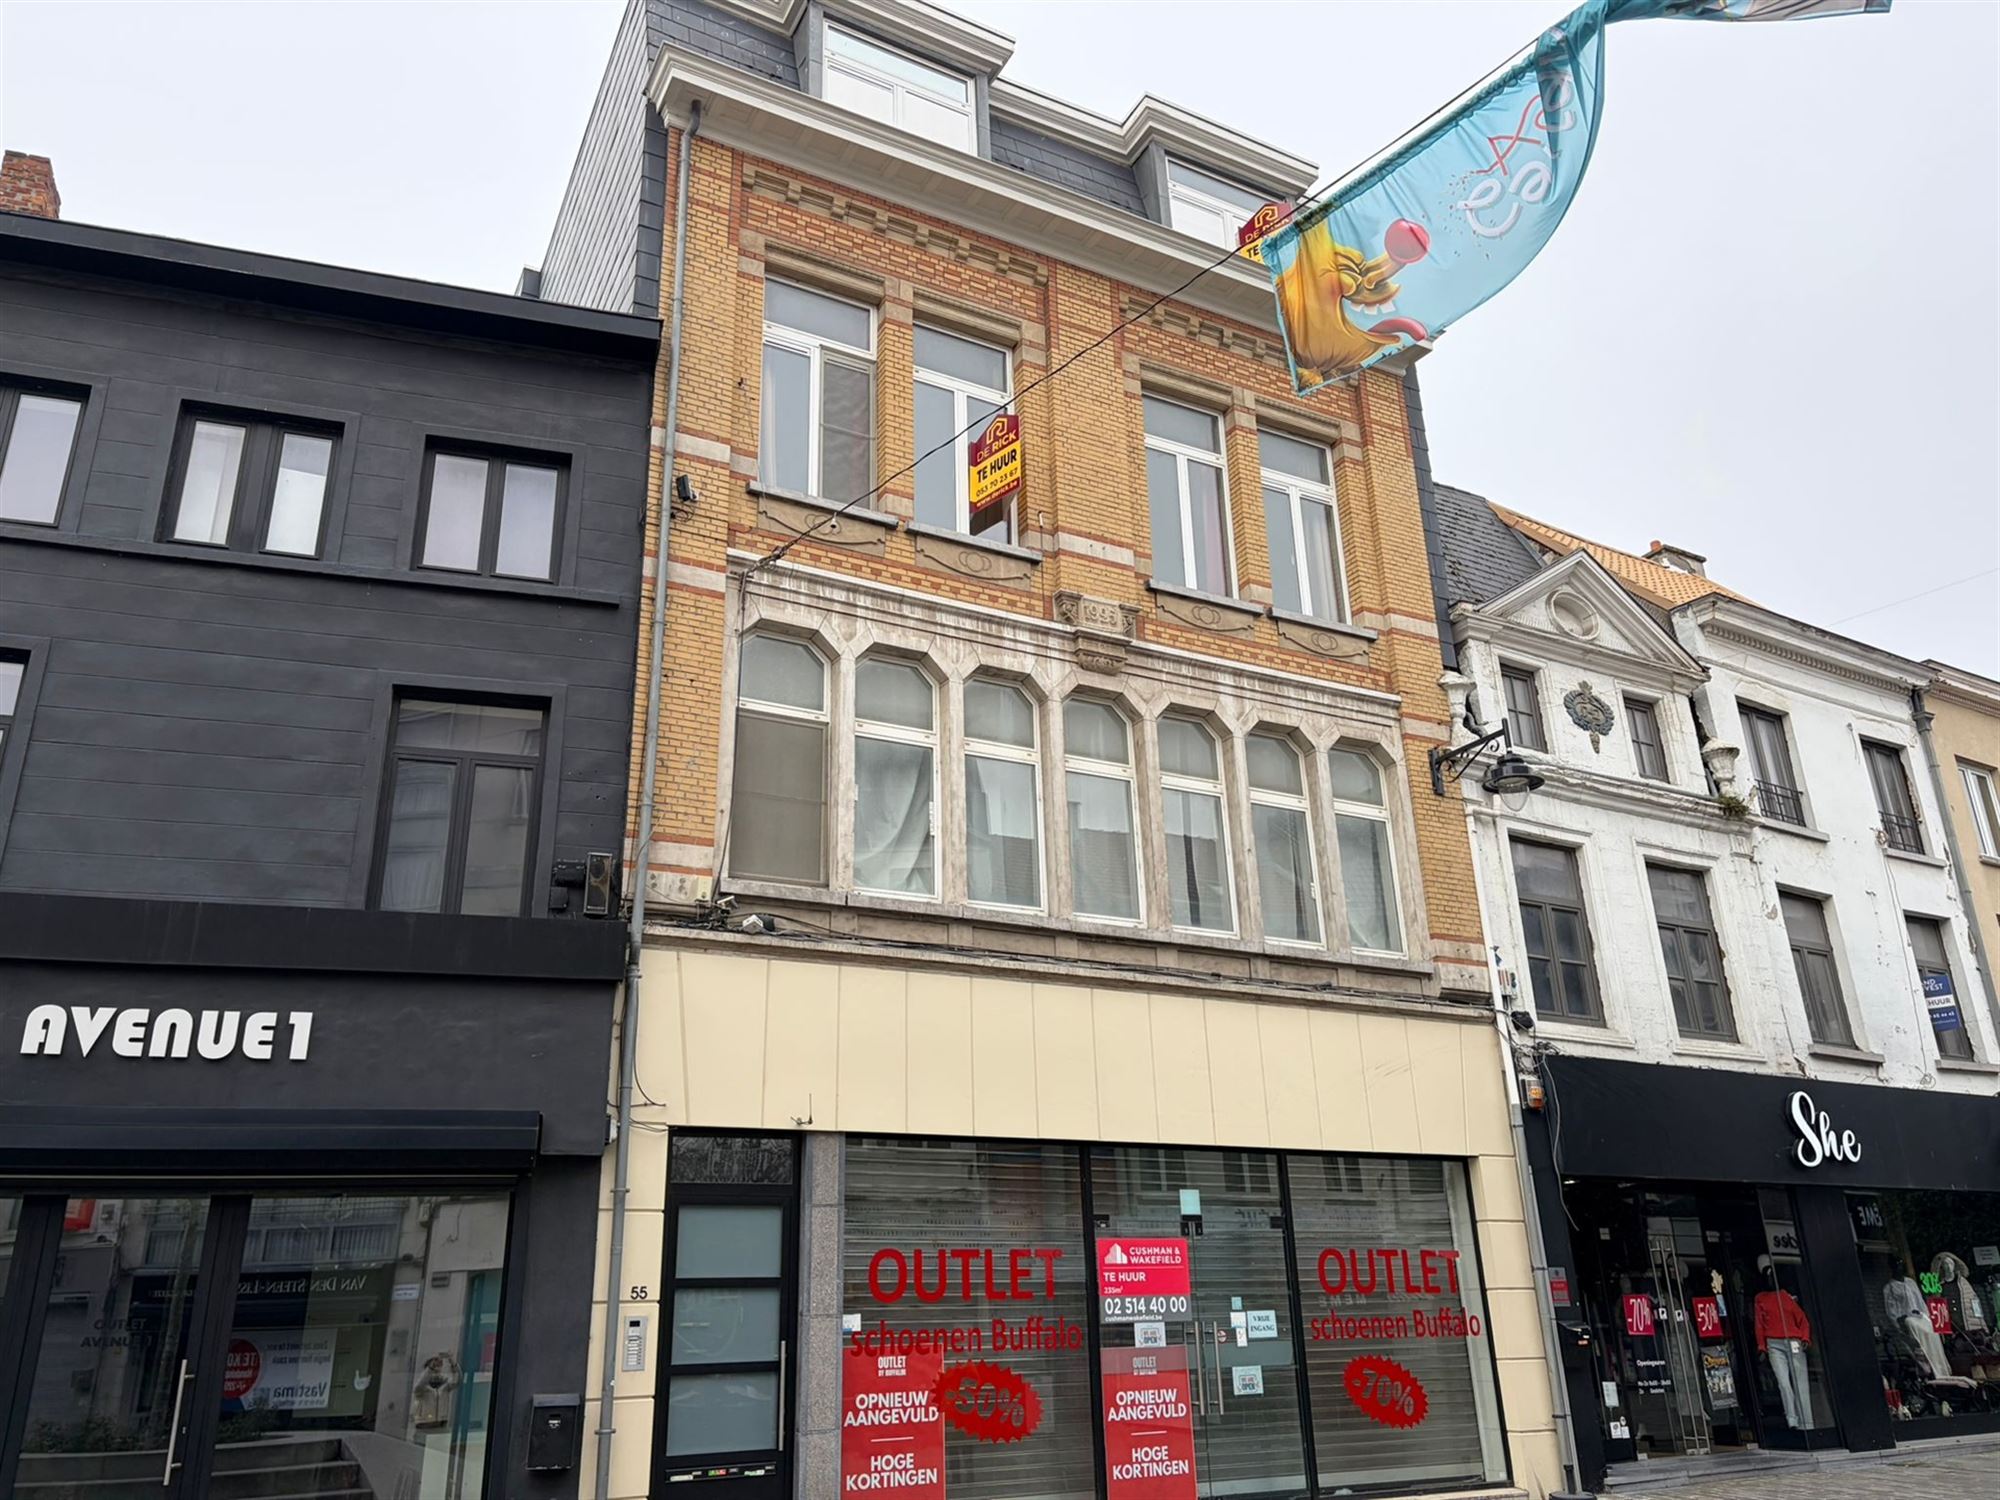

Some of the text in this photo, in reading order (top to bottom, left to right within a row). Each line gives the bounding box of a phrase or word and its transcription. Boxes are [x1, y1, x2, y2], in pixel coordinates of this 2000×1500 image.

[1246, 244, 1260, 259] TE
[976, 429, 1018, 463] DE RICK
[976, 448, 1018, 483] TE HUUR
[1791, 1090, 1861, 1167] She
[1129, 1247, 1181, 1255] CUSHMAN &
[1129, 1256, 1182, 1265] WAKEFIELD
[868, 1248, 1063, 1303] OUTLET
[1103, 1272, 1146, 1282] TE HUUR
[1317, 1248, 1461, 1296] OUTLET
[630, 1286, 648, 1300] 55
[1105, 1296, 1187, 1315] 02 514 40 00
[1627, 1298, 1652, 1332] -70%
[1310, 1306, 1482, 1342] schoenen Buffalo
[1697, 1303, 1718, 1332] -50%
[850, 1315, 1083, 1358] schoenen Buffalo
[877, 1356, 907, 1369] OUTLET
[1133, 1356, 1156, 1369] OUTLET
[855, 1390, 929, 1410] OPNIEUW
[944, 1376, 1026, 1428] -50%
[1115, 1388, 1178, 1406] OPNIEUW
[1352, 1367, 1415, 1417] -70%
[843, 1406, 940, 1428] AANGEVULD
[1107, 1402, 1188, 1422] AANGEVULD
[870, 1452, 915, 1472] HOGE
[1132, 1445, 1169, 1462] HOGE
[846, 1467, 938, 1491] KORTINGEN
[1112, 1459, 1190, 1480] KORTINGEN
